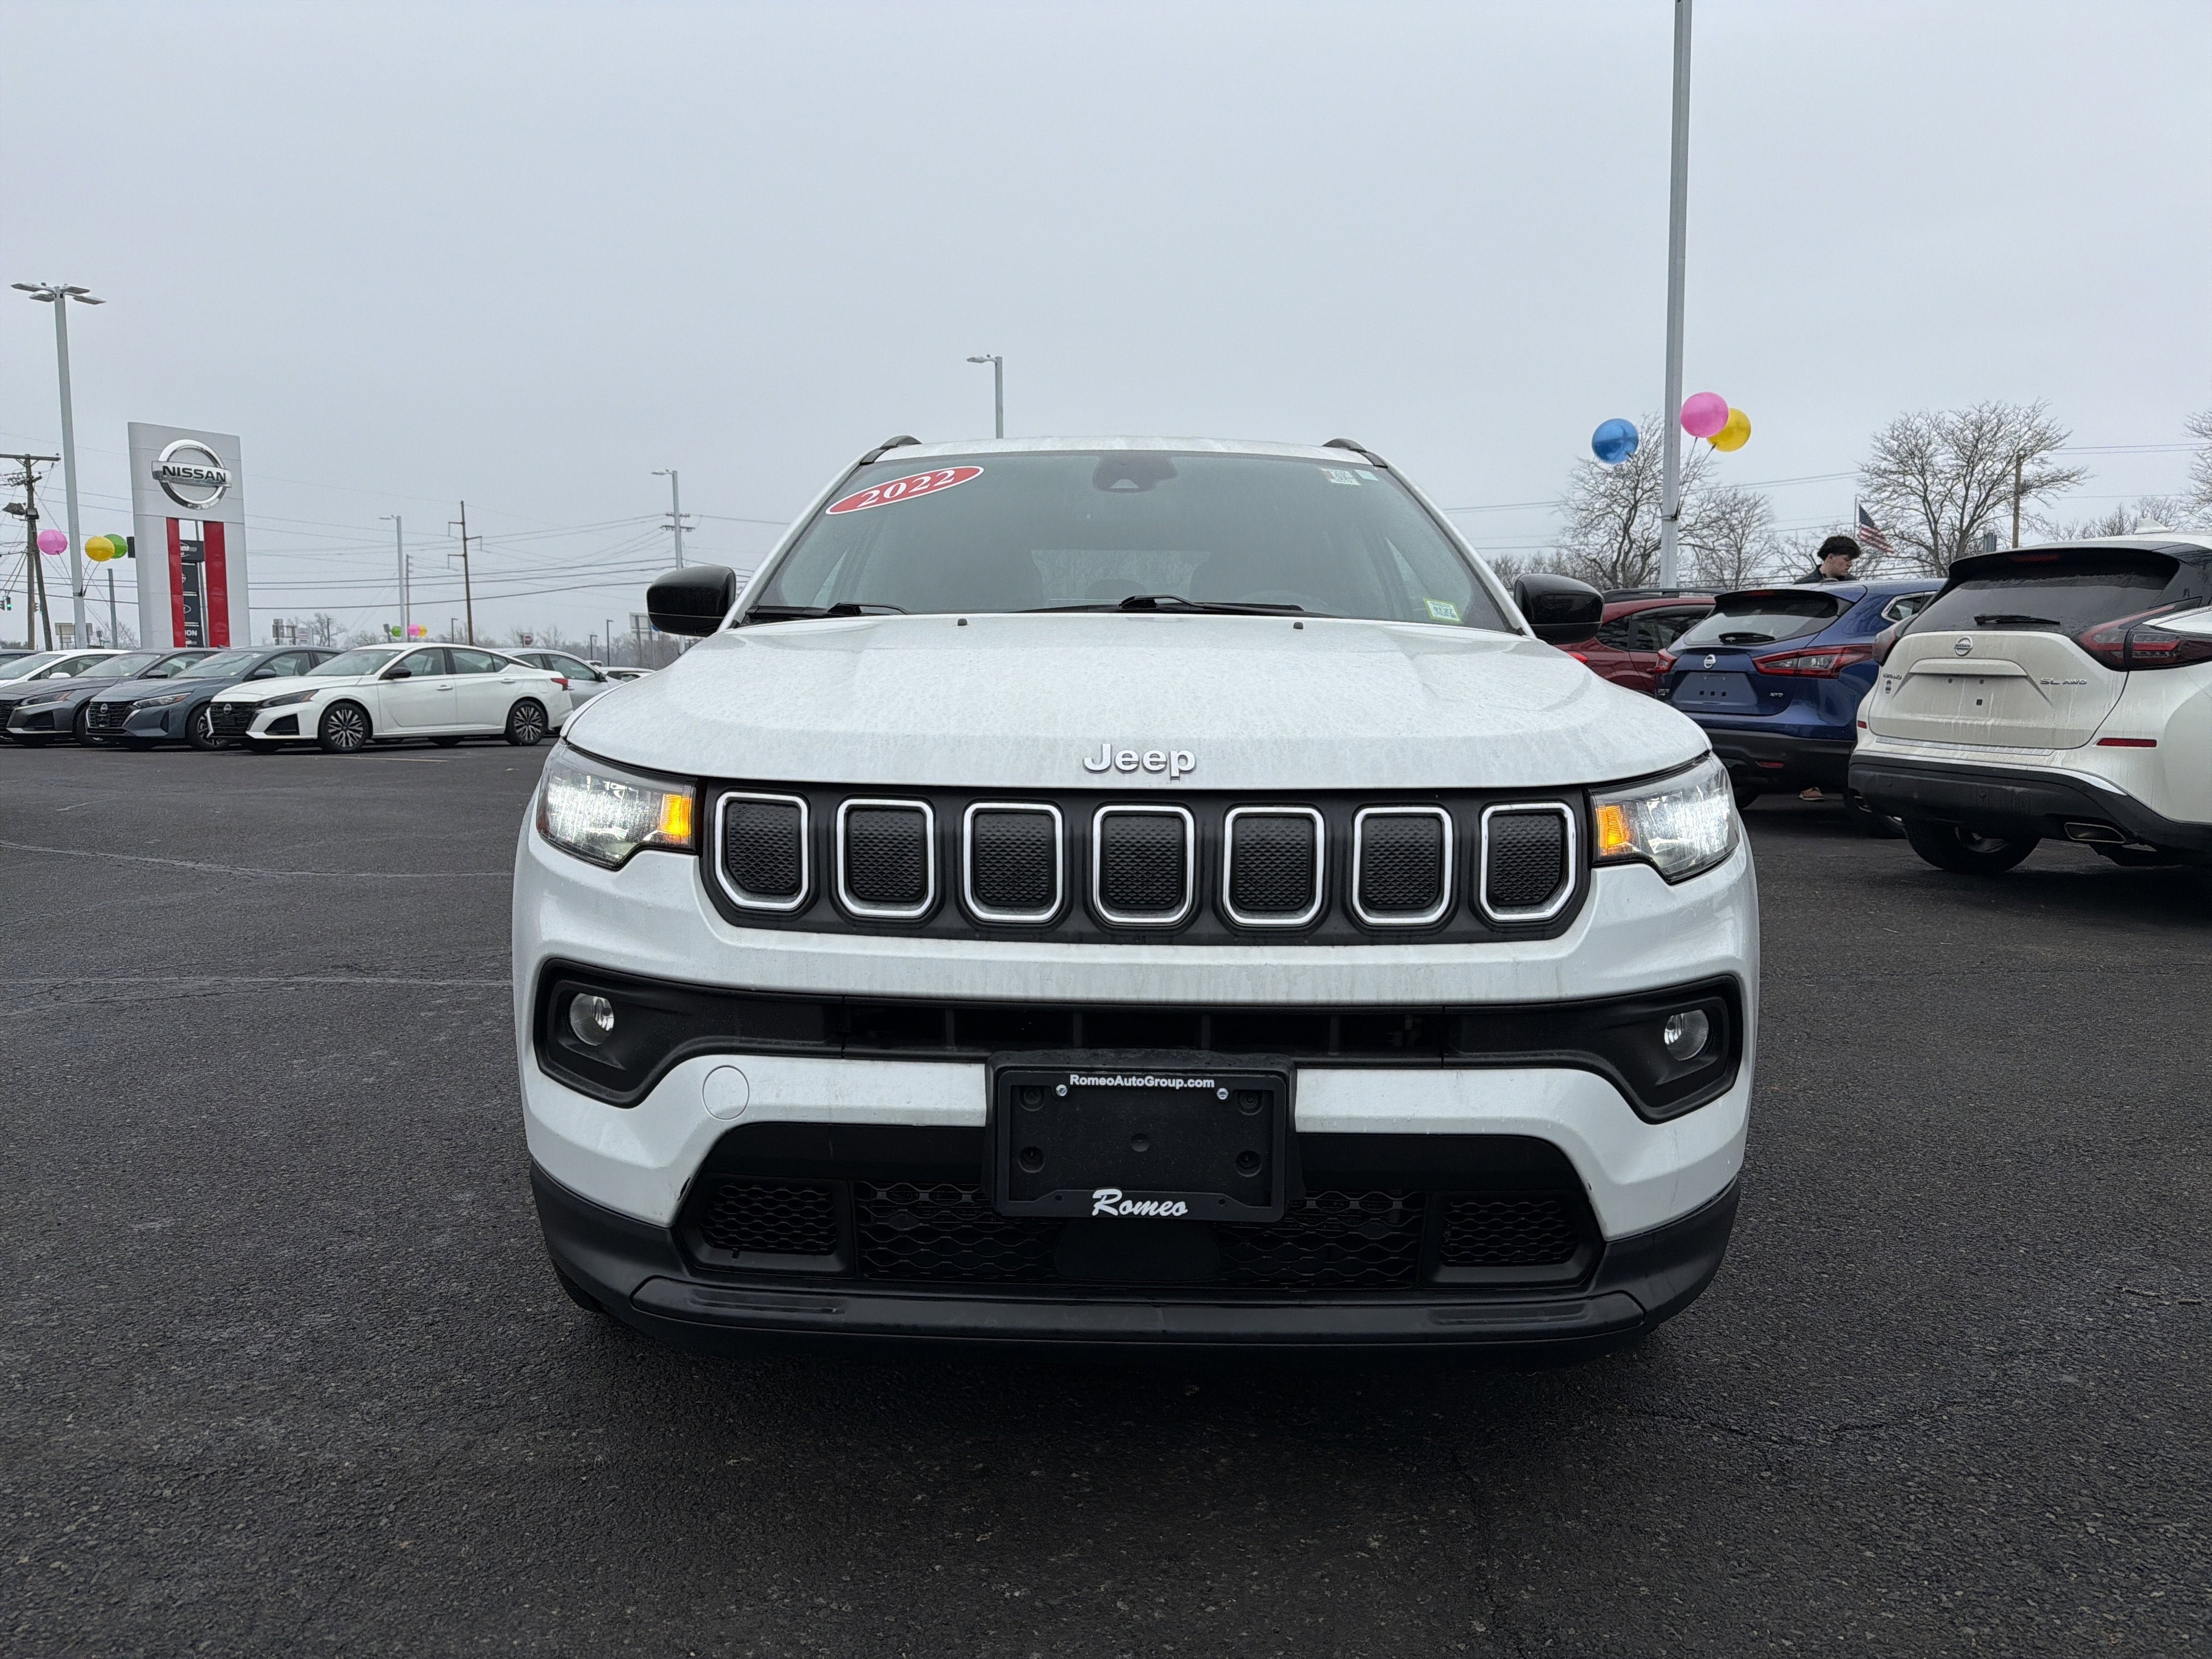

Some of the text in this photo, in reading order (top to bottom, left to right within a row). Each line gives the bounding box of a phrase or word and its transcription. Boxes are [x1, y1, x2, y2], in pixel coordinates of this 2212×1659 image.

[162, 465, 226, 482] NISSAN
[856, 470, 955, 507] 2022
[1084, 743, 1196, 779] Jeep
[1070, 1075, 1215, 1090] RomeoAutoGroup.com
[1092, 1188, 1188, 1216] Romeo
